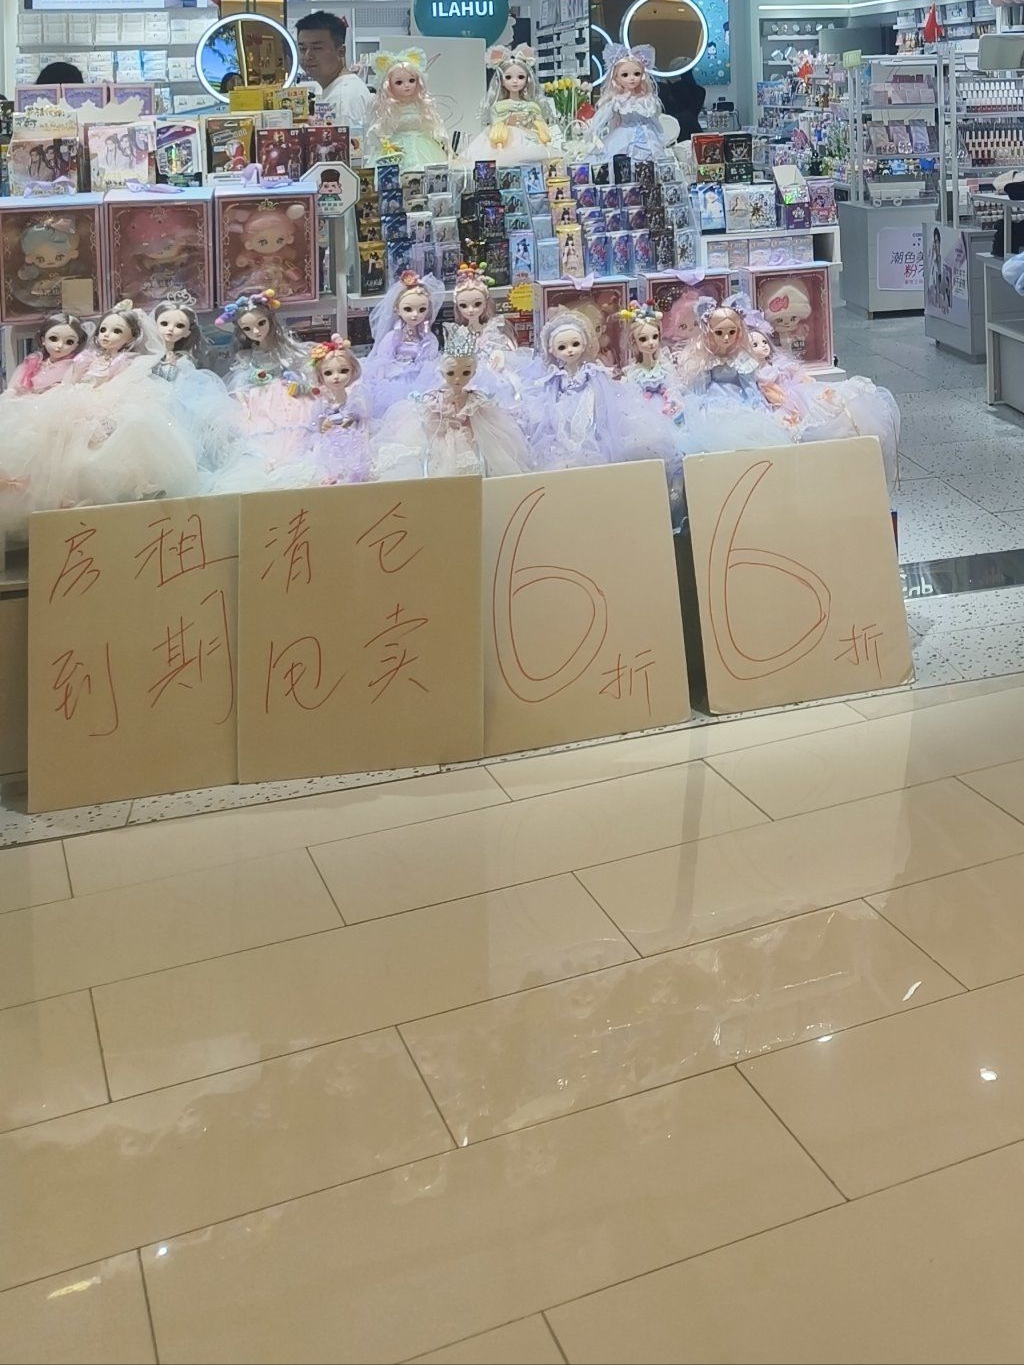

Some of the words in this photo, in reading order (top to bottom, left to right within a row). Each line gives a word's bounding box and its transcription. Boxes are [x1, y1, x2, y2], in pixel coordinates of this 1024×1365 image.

[432, 0, 494, 18] ILAHUI
[50, 514, 239, 604] 房租
[261, 502, 424, 594] 清仓
[493, 486, 656, 717] 6折
[708, 460, 885, 681] 6折
[52, 589, 235, 737] 到期
[266, 603, 430, 714] 甩卖
